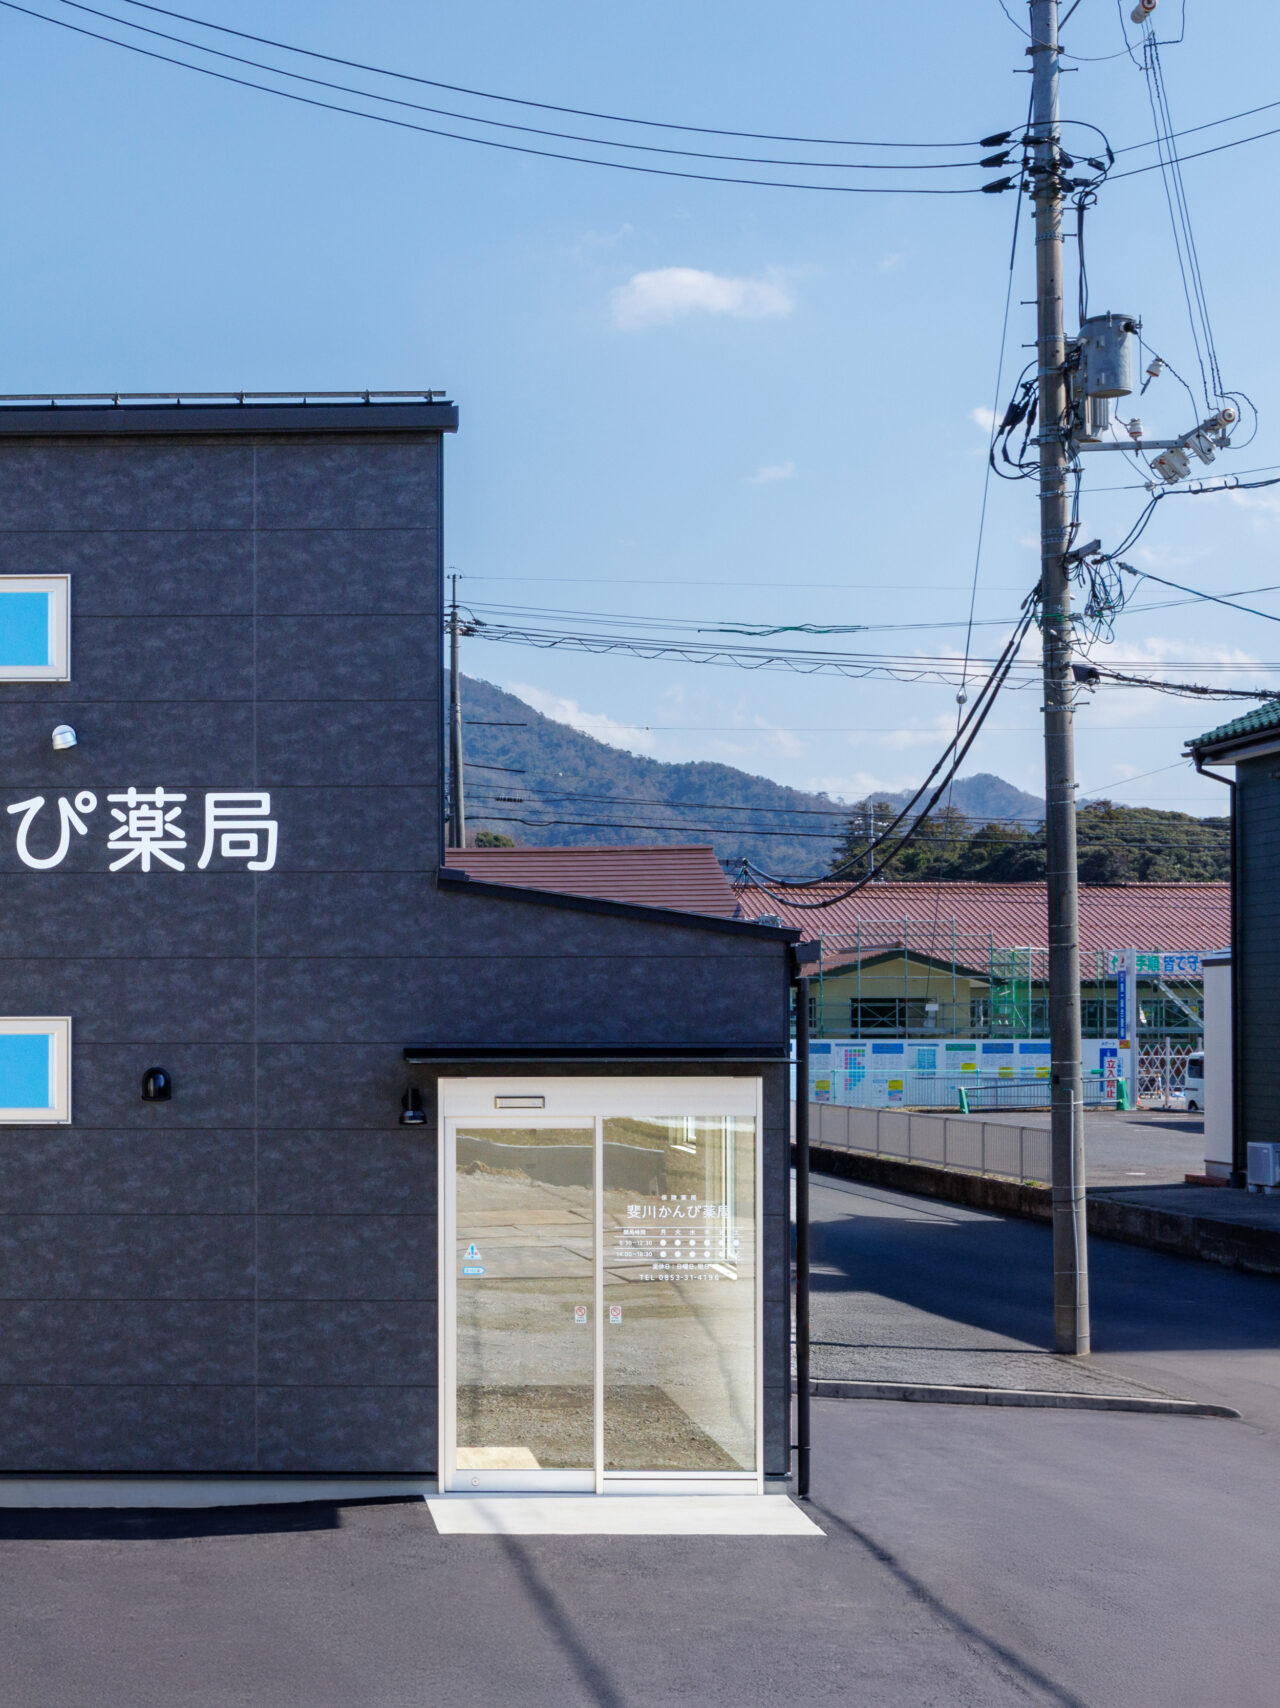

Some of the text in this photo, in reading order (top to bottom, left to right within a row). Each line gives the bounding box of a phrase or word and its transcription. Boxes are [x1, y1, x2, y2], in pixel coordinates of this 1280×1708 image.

[1106, 1059, 1116, 1098] 立入禁止
[626, 1204, 730, 1219] 斐川かんぴ薬局
